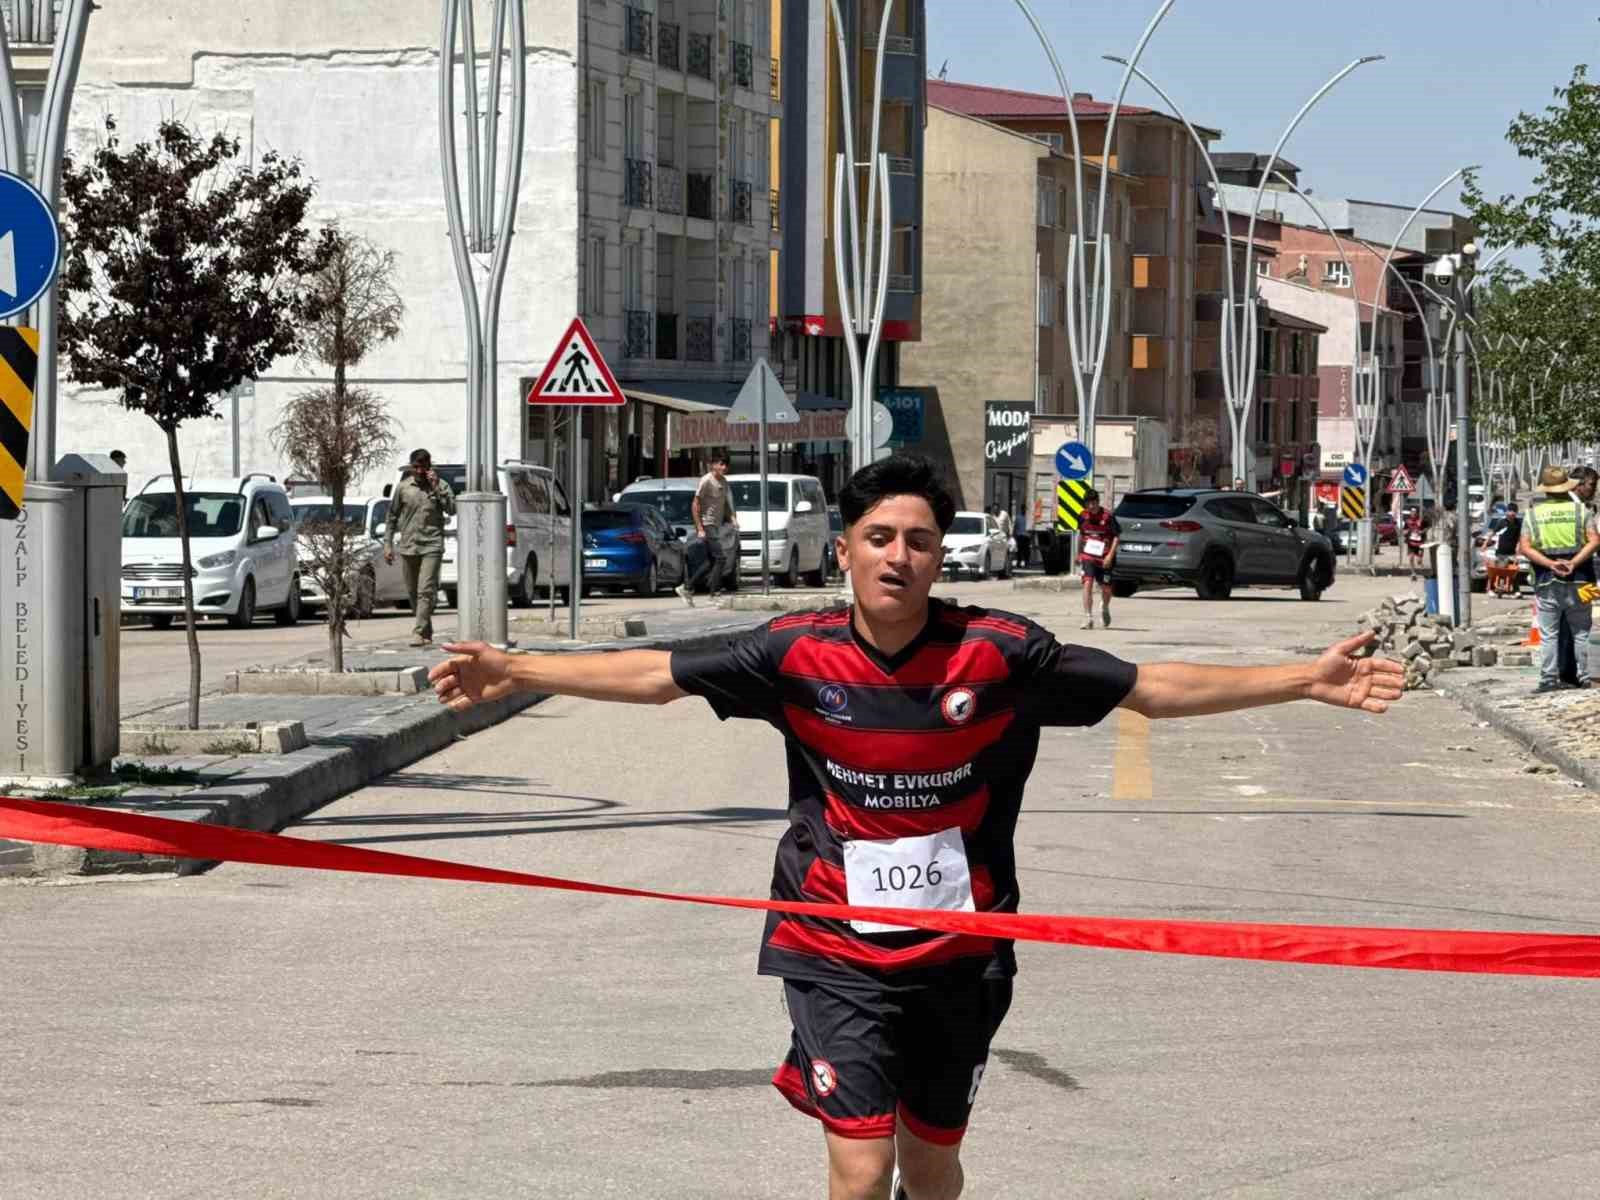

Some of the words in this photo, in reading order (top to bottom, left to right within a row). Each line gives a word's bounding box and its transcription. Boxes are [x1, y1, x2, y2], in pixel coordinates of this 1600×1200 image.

[988, 410, 1030, 426] MODA
[15, 602, 29, 772] BELEDİYESİ
[894, 762, 972, 789] EVKURAR
[864, 792, 940, 809] MOBİLYA
[871, 860, 942, 892] 1026
